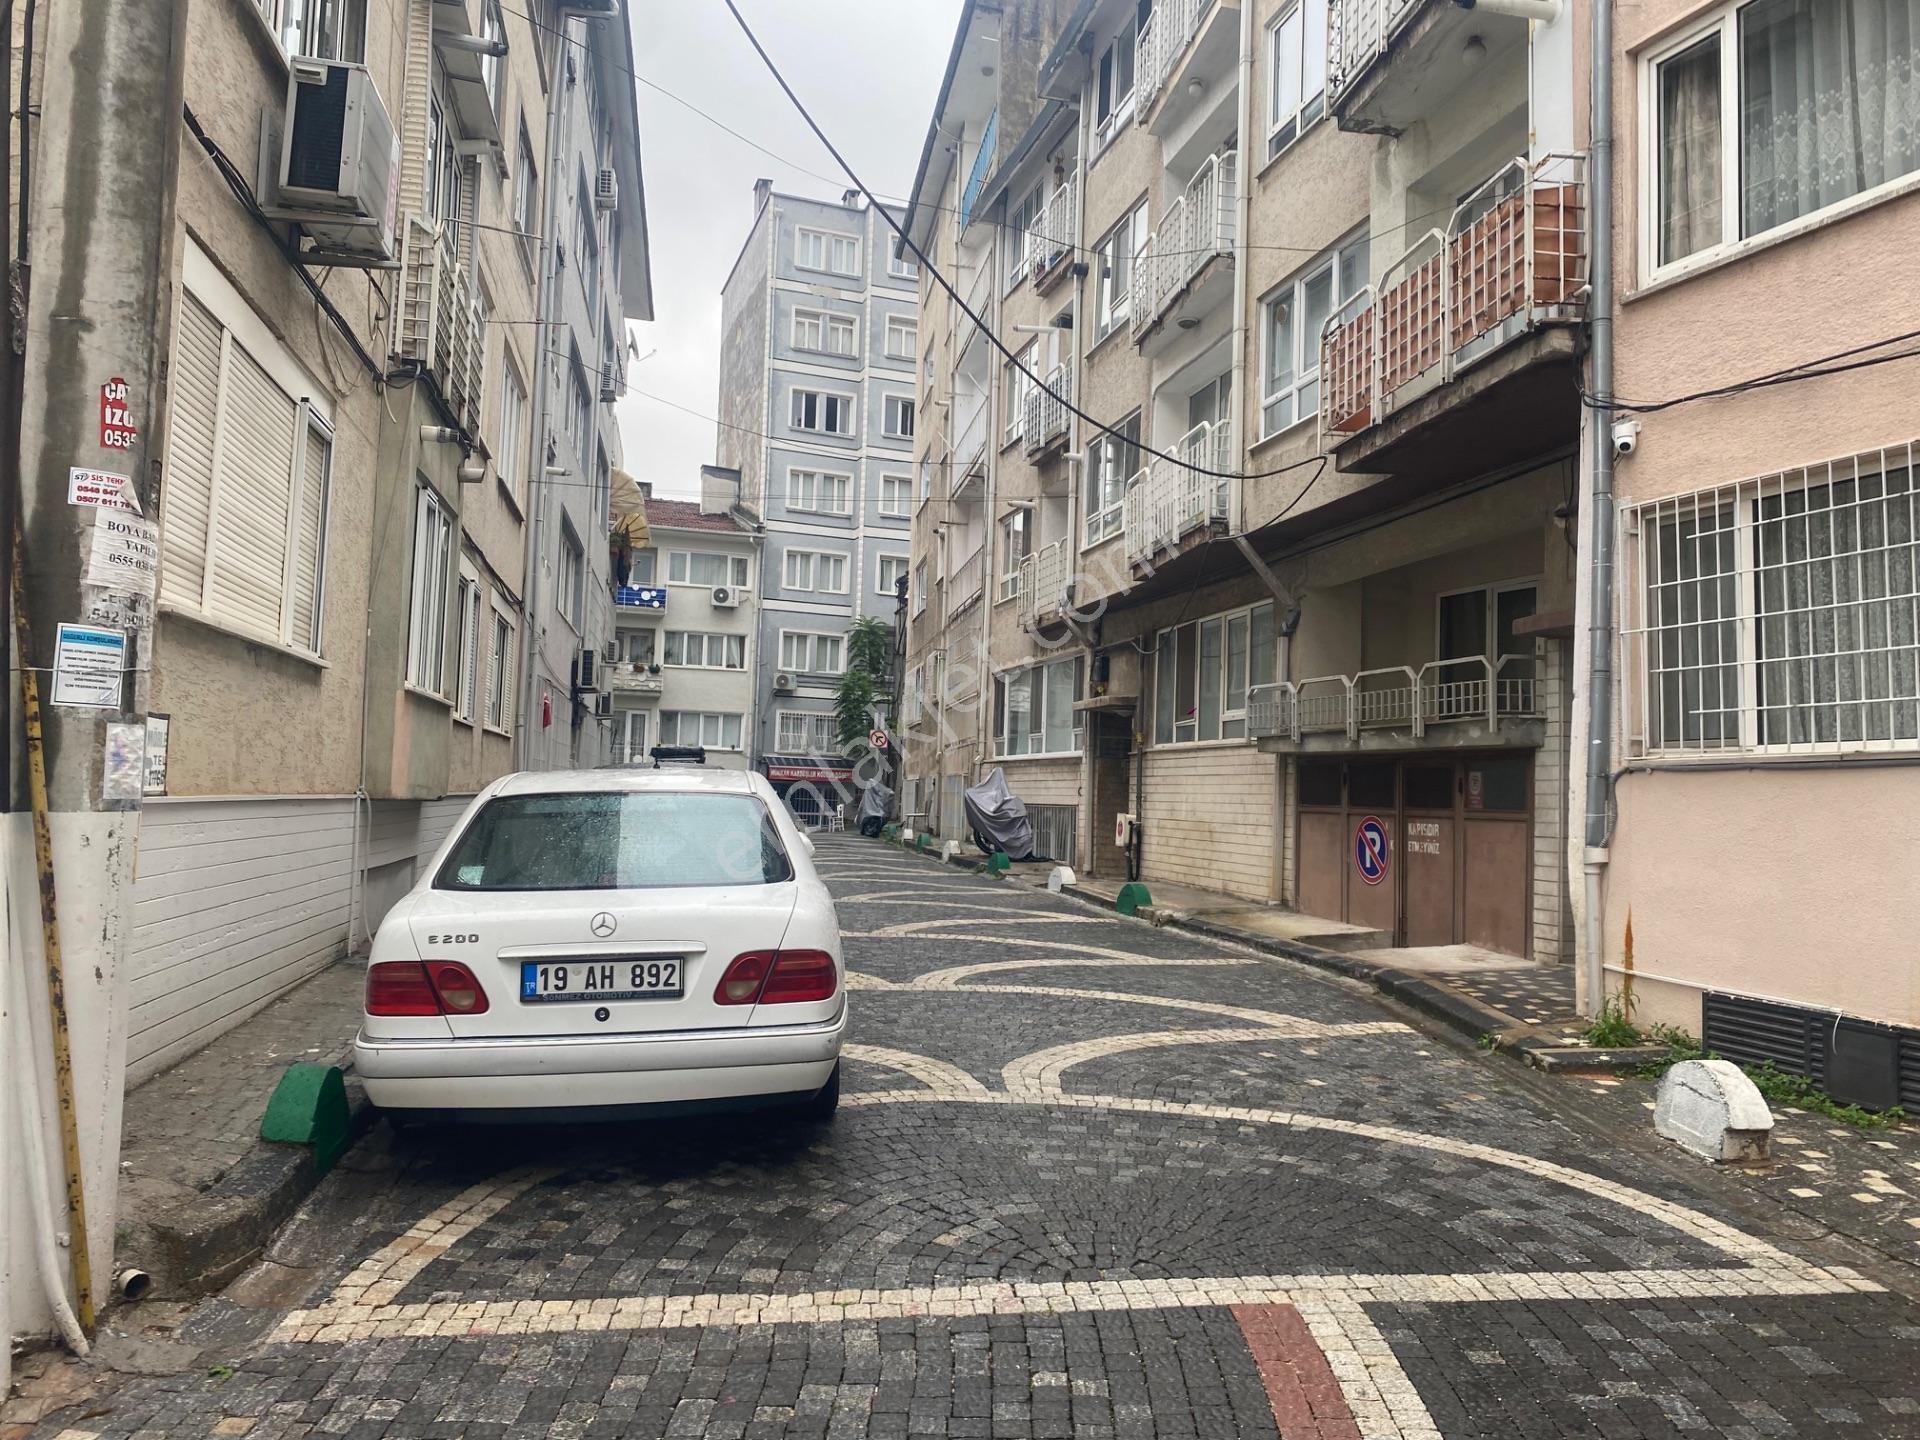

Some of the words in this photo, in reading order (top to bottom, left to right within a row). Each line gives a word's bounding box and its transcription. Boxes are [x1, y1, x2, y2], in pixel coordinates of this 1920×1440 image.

[107, 520, 140, 537] BOYA
[109, 553, 133, 567] 0555
[1408, 823, 1440, 837] KAPISIDIR
[428, 935, 439, 944] E
[442, 934, 479, 944] 200
[525, 982, 536, 990] TR
[539, 966, 568, 991] 19
[585, 965, 614, 990] AH
[631, 963, 676, 988] 892
